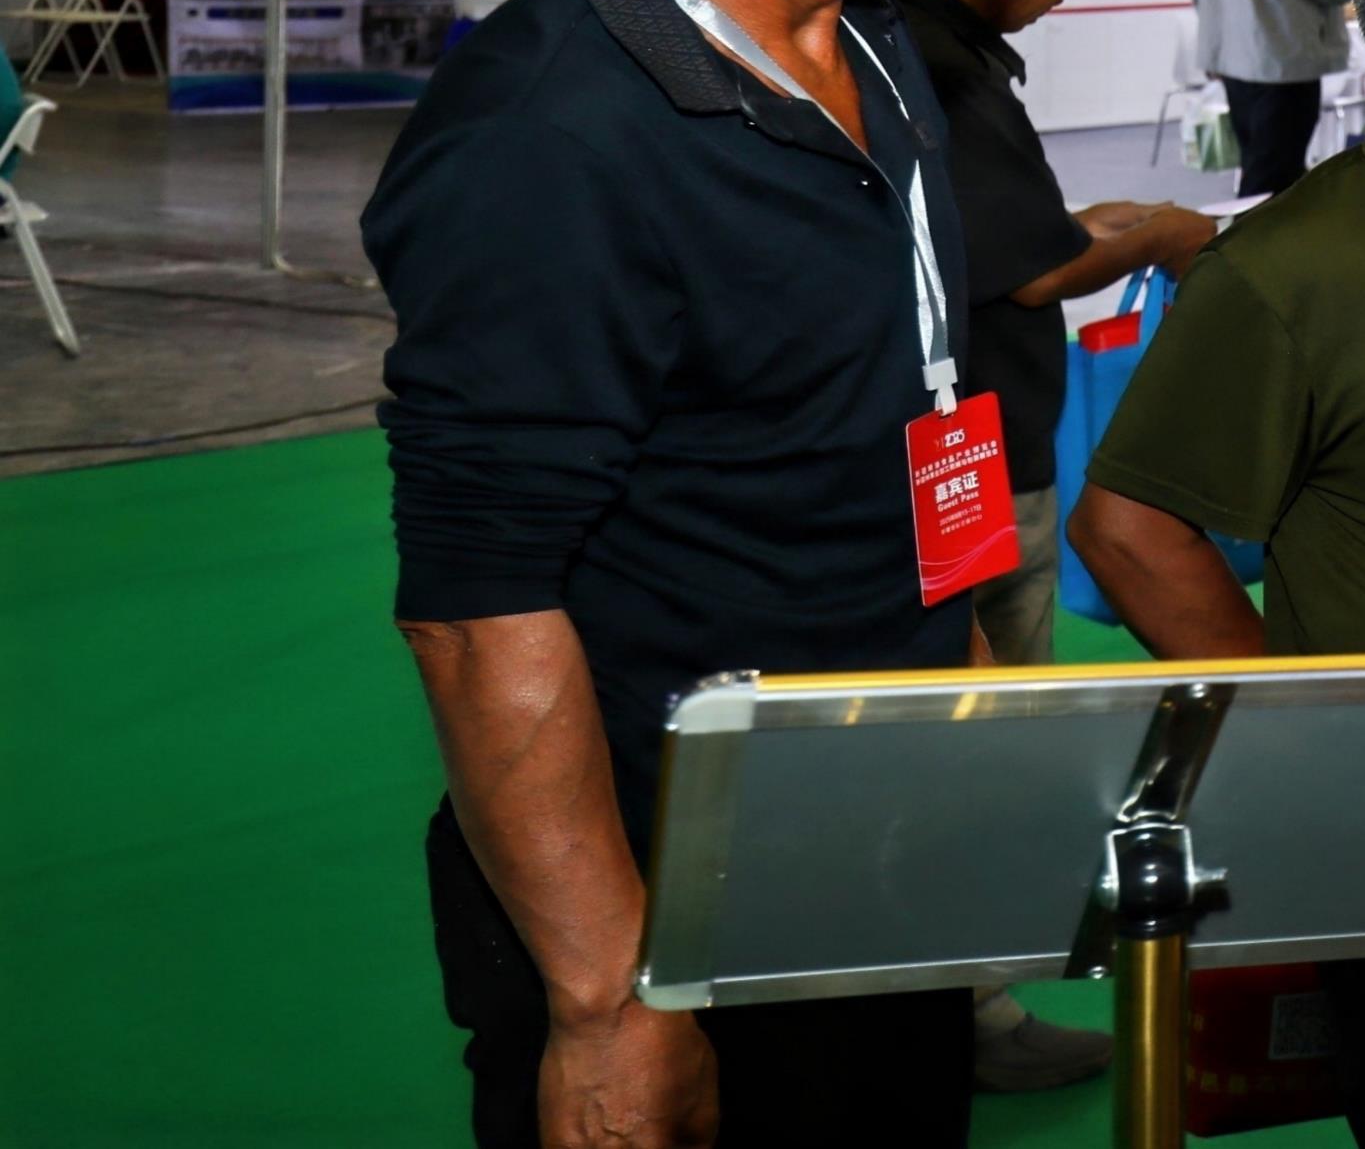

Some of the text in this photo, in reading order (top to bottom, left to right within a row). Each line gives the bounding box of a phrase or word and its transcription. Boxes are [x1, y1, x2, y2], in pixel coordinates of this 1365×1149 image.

[934, 470, 980, 503] 嘉宾证
[937, 491, 979, 512] Guest Pass
